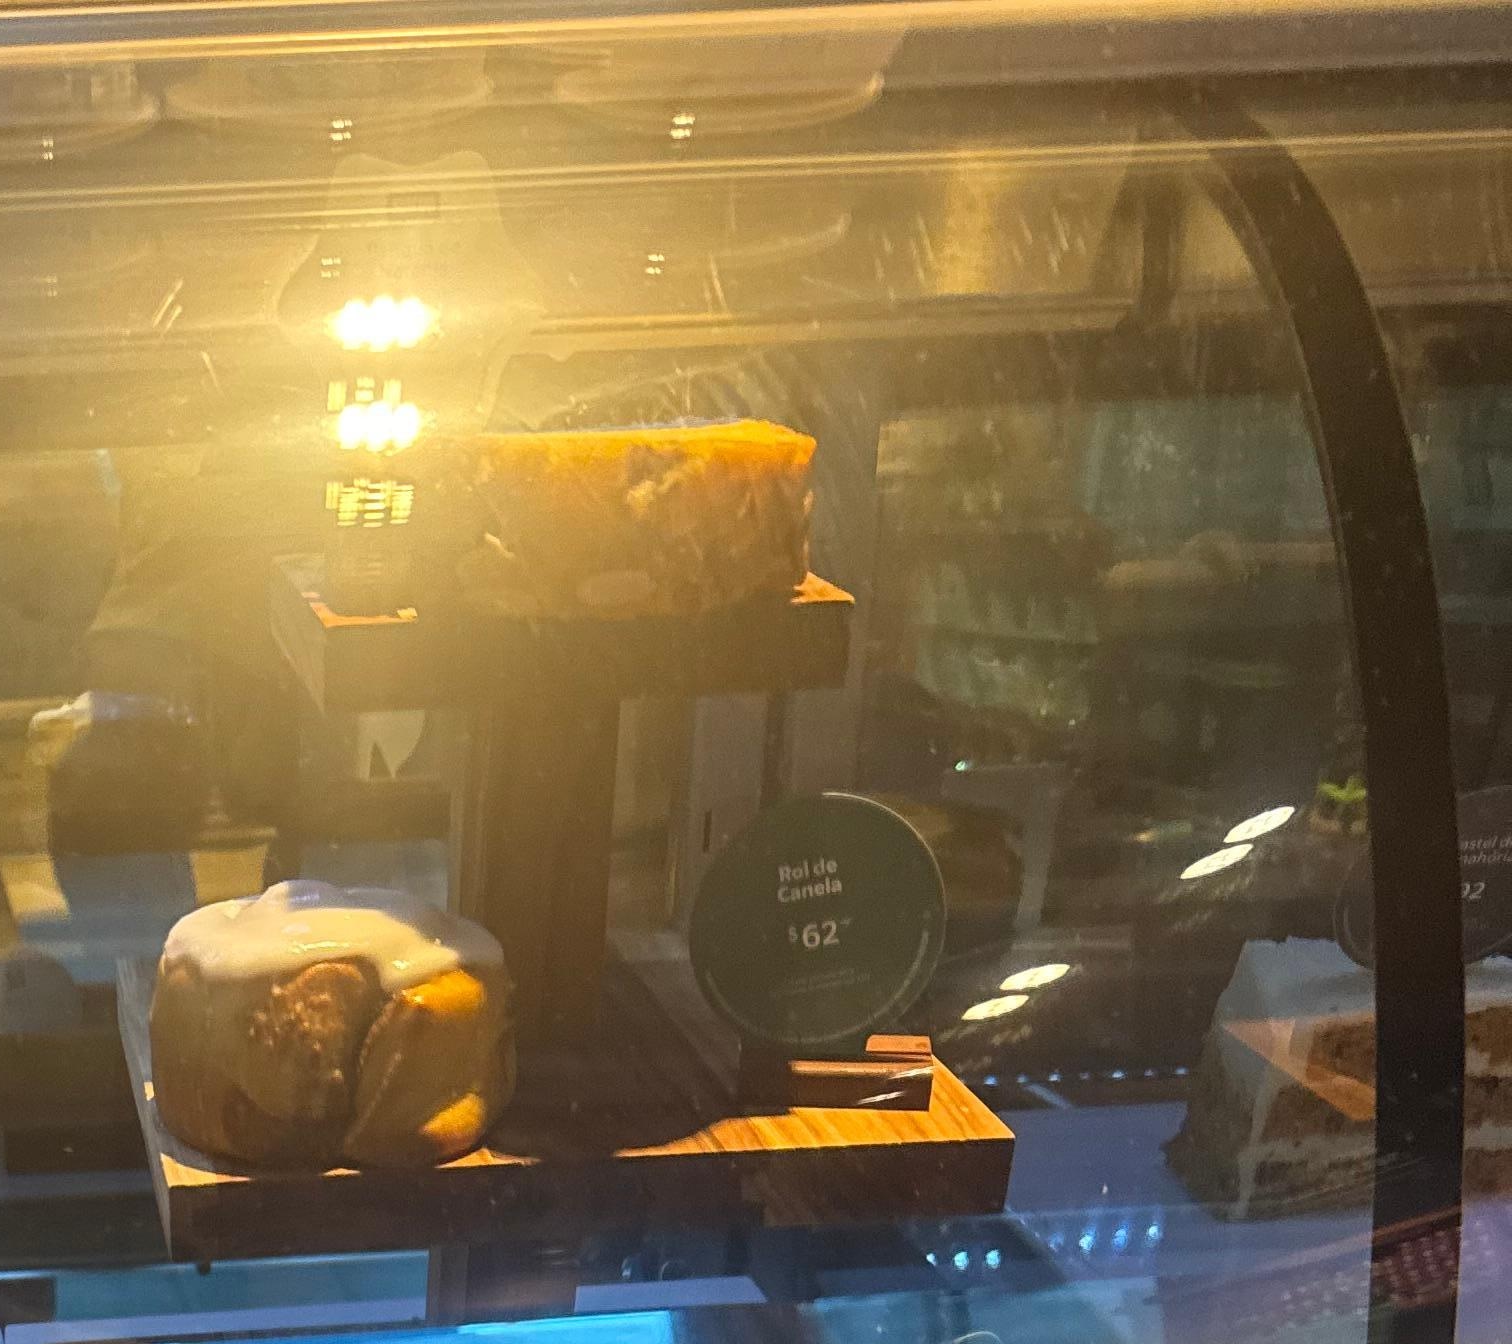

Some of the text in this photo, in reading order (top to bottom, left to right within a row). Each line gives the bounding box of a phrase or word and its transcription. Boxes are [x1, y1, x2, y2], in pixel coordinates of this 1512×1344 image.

[778, 856, 838, 883] Rol de
[777, 877, 843, 903] Canela
